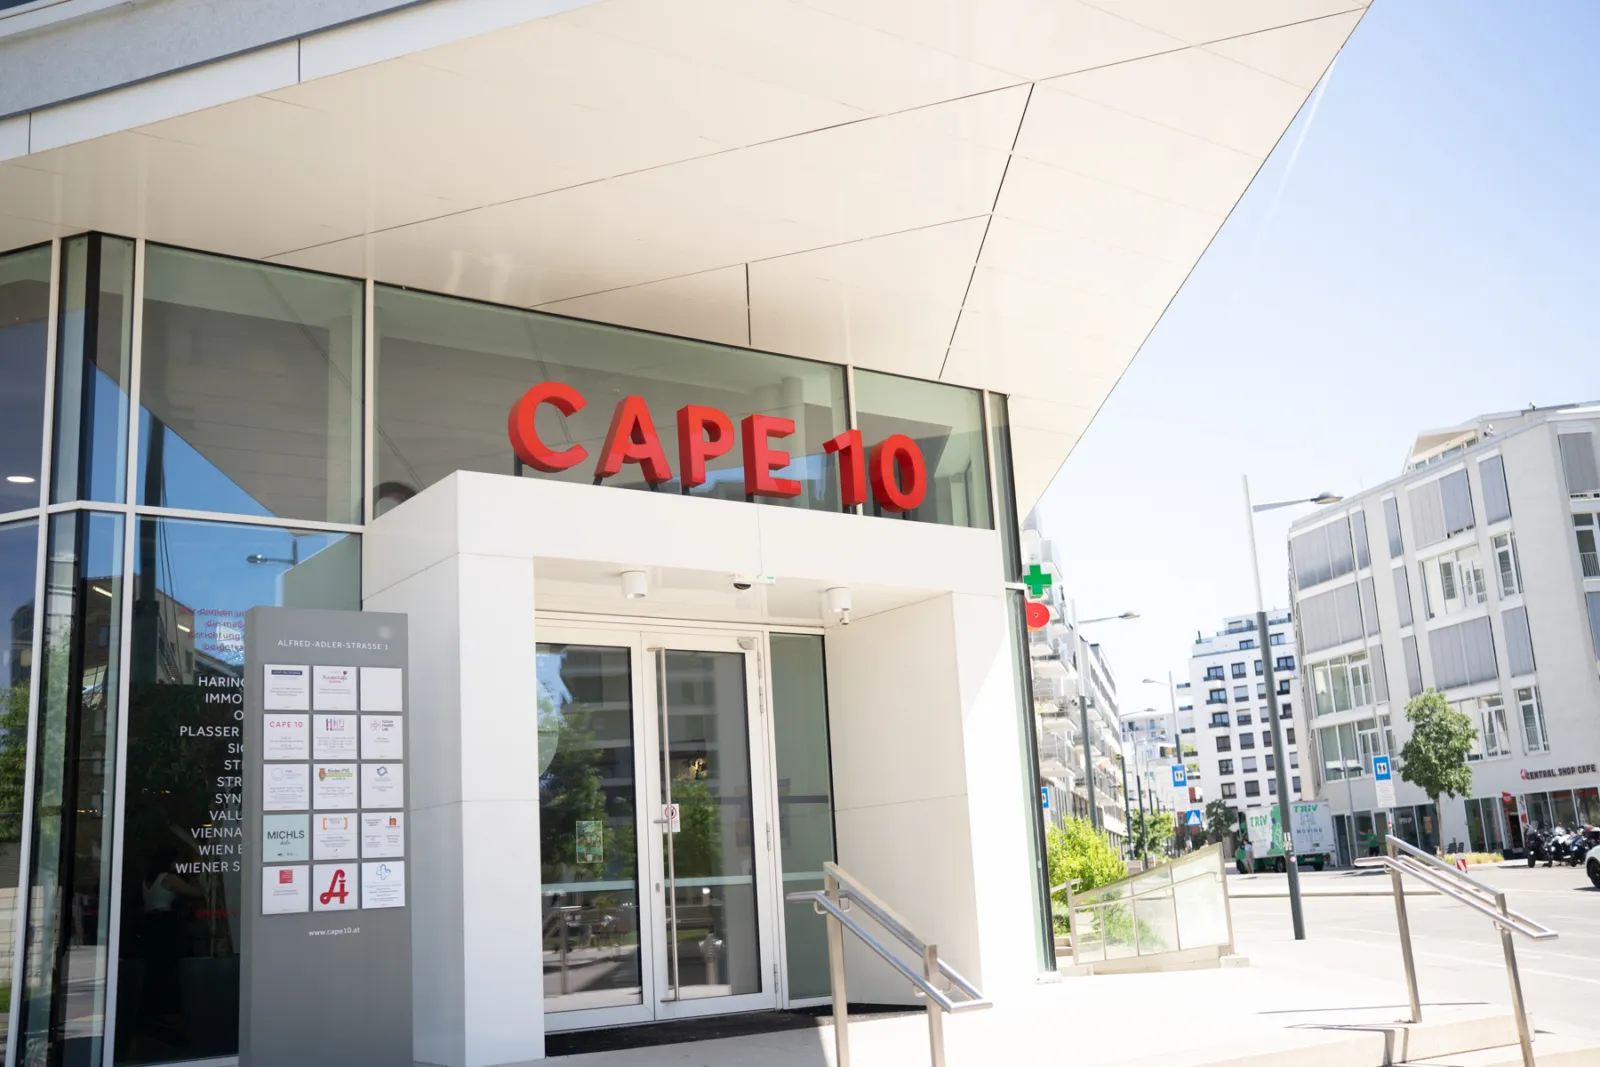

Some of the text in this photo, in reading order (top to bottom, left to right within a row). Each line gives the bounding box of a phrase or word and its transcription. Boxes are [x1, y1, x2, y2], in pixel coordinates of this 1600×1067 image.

[508, 381, 927, 513] CAPE 10
[277, 639, 382, 651] ALFRED-ADLER-STRASSE
[205, 693, 242, 704] IMMO
[180, 726, 240, 737] PLASSER
[1526, 764, 1597, 780] CENTRAL SHOP CAFE
[215, 793, 242, 804] SYN
[191, 827, 242, 839] VIENNA
[267, 830, 305, 840] MICHLS
[198, 844, 234, 855] WIEN
[175, 861, 241, 874] WIENER S
[308, 927, 360, 936] www.cape10.at
